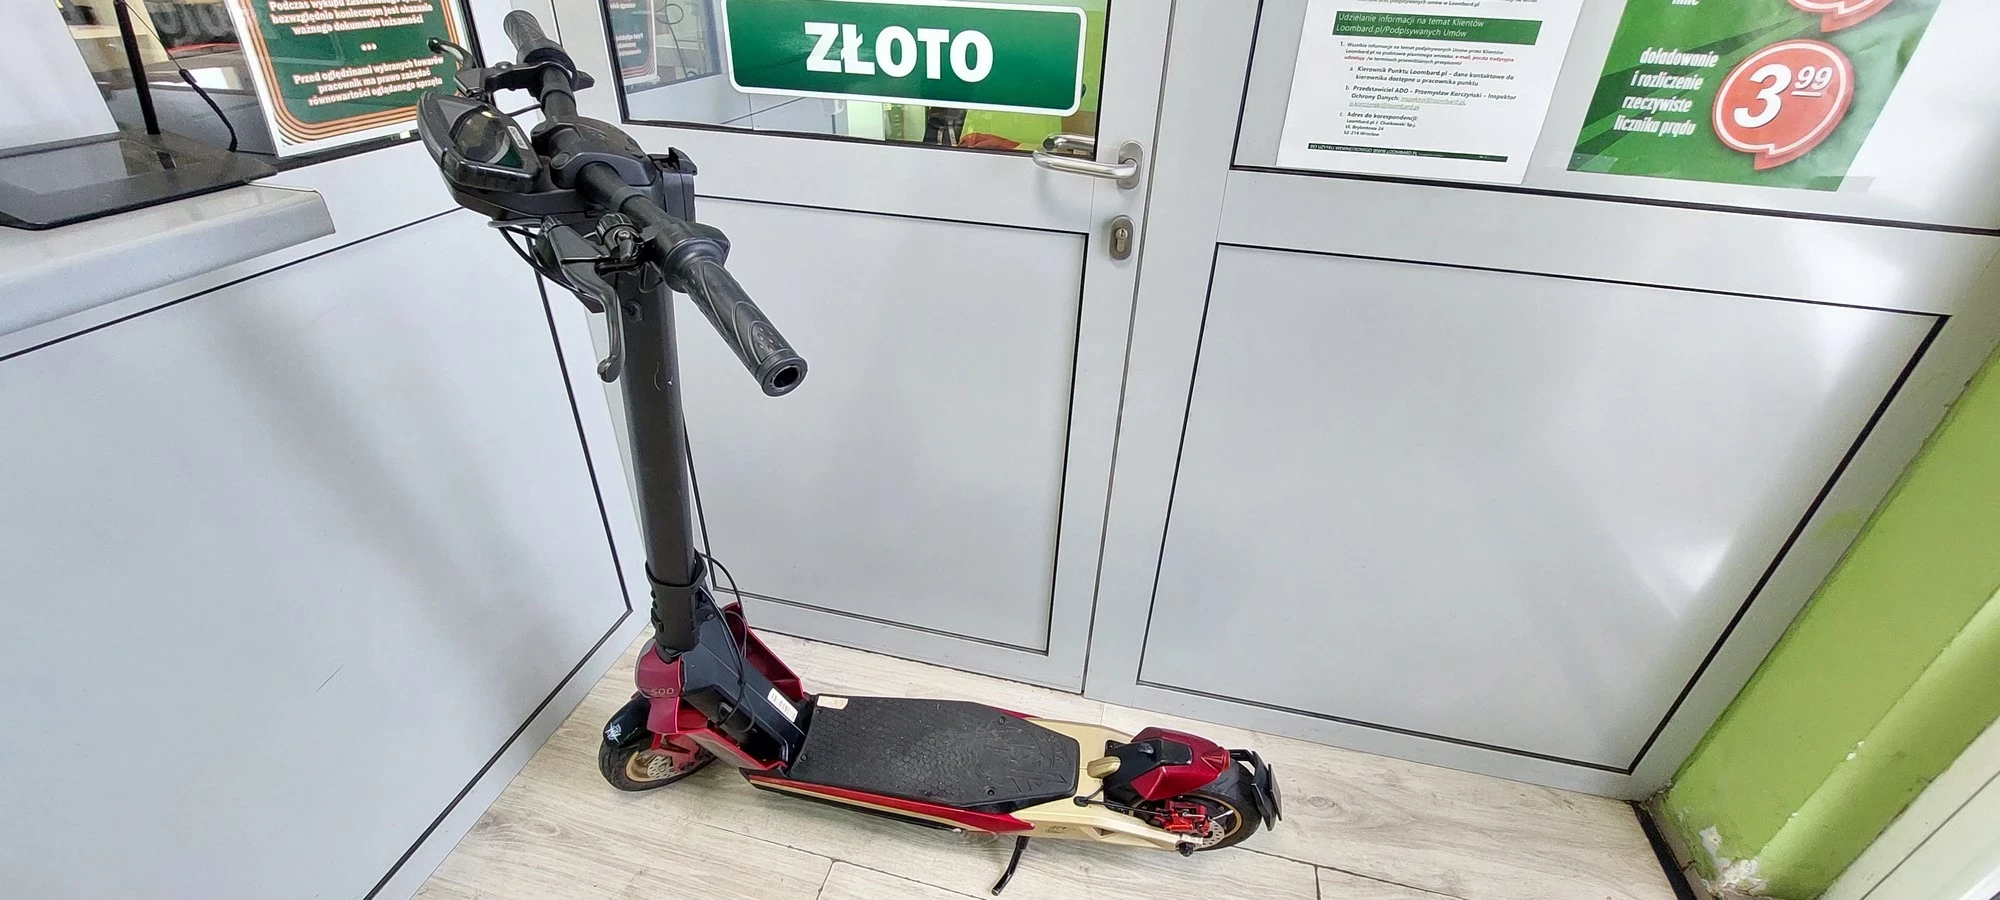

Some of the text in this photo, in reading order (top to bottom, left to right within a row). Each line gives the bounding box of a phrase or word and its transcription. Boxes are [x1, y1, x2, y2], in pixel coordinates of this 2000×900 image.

[268, 0, 310, 11] Podczas
[311, 0, 345, 10] wykupu
[269, 2, 433, 24] bezwzględnie koniecznym jest okazanie
[291, 13, 424, 36] ważnego dokumentu tożsamości
[1338, 13, 1484, 28] Udzielanie informacji na temat Klientów
[1336, 24, 1468, 38] Loombard.pl/Podpisywanych Umów
[804, 21, 994, 83] ZŁOTO
[1640, 46, 1719, 67] doładowanie
[292, 55, 444, 85] Przed oględzinami wybranych towarów
[1387, 67, 1408, 75] Punktu
[1409, 69, 1448, 77] Loombard.pl
[1469, 72, 1505, 80] kontaktowe
[1630, 70, 1704, 90] i rozliczenie
[317, 67, 431, 94] pracownik ma prawo zażądać
[1388, 75, 1416, 83] dostępne
[1421, 78, 1456, 86] pracownika
[308, 76, 443, 106] równowartości oglądanego sprzętu
[1351, 92, 1376, 100] Ochrony
[1353, 85, 1394, 93] Przedstawiciel
[1414, 89, 1449, 97] Przemysław
[1450, 91, 1482, 99] Korczyński
[1621, 96, 1693, 114] rzeczywiste
[1613, 114, 1697, 138] licznika prądu
